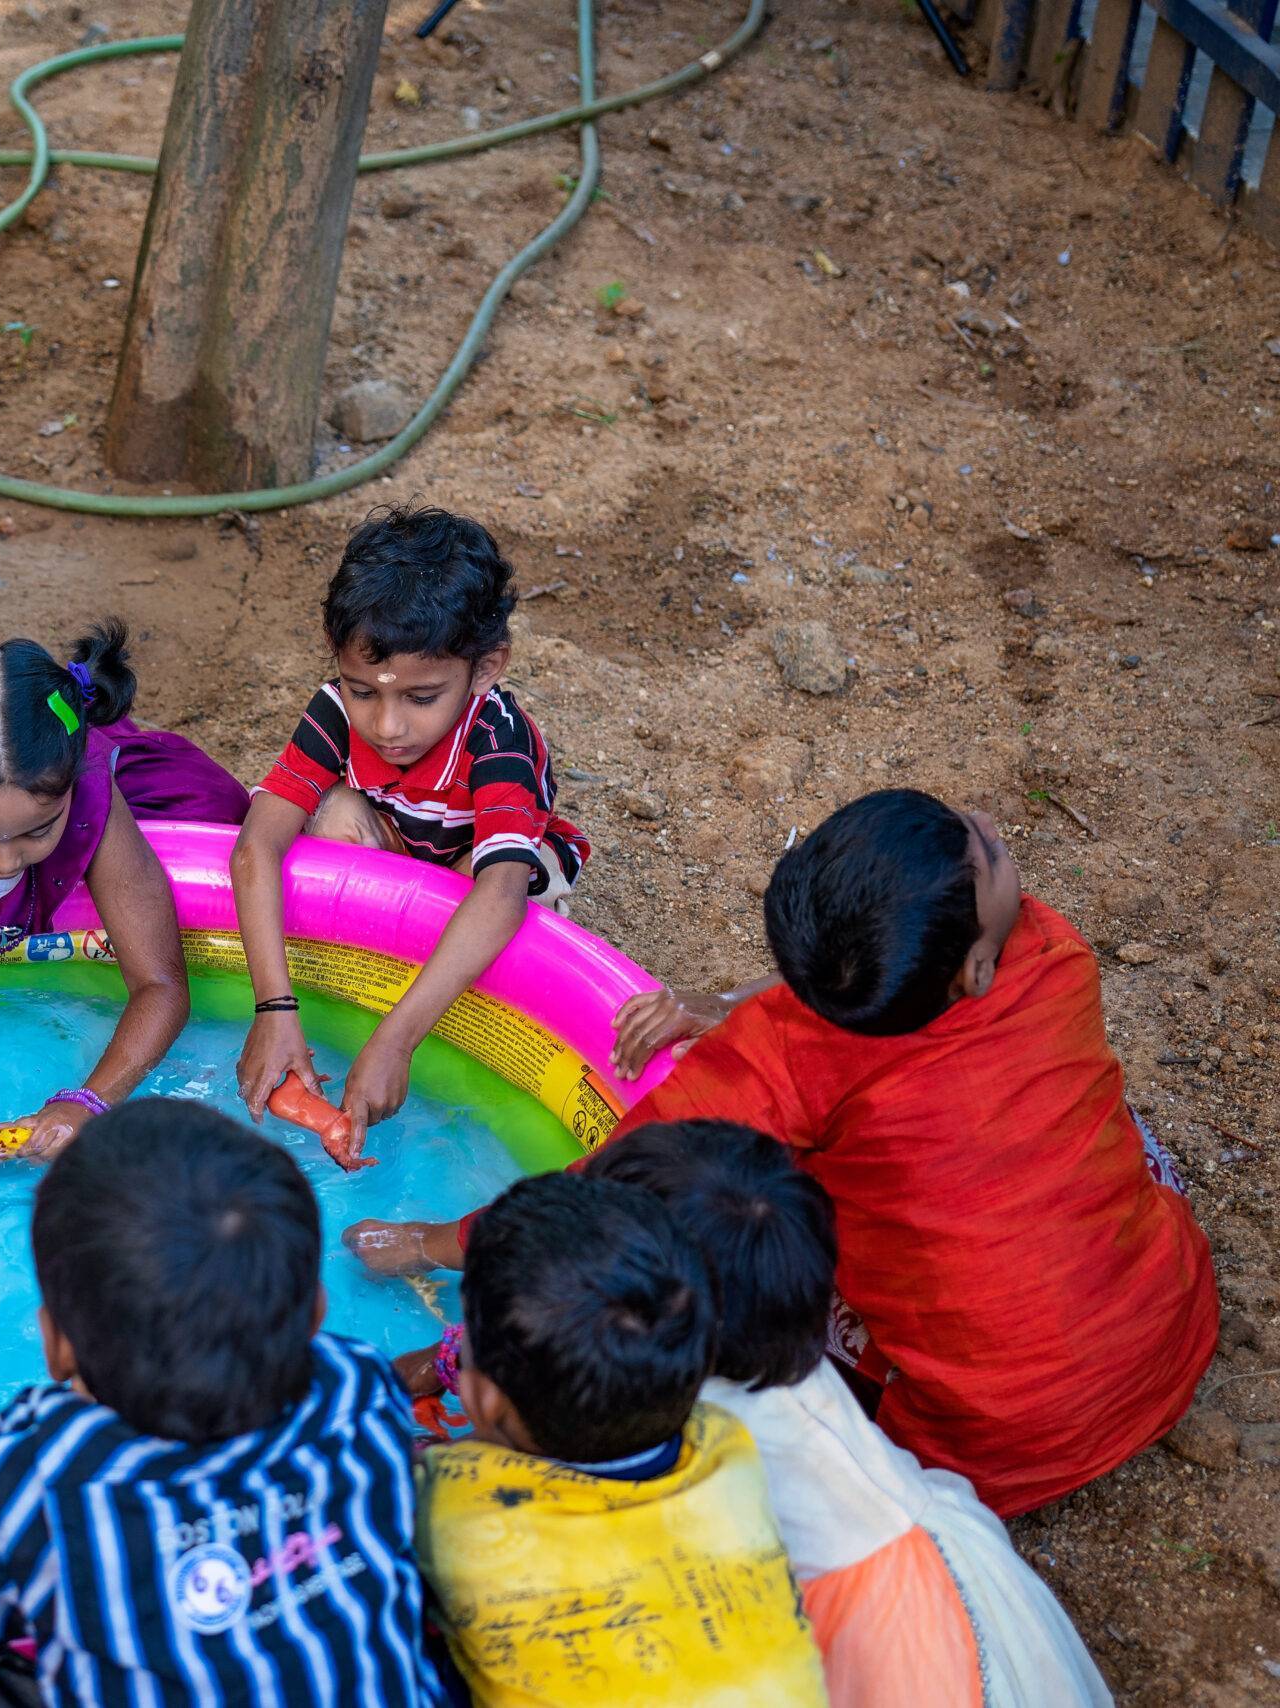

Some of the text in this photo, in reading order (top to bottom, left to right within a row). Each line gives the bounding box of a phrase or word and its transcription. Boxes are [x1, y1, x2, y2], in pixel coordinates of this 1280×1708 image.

[577, 1081, 587, 1092] NO
[584, 1088, 601, 1107] DIVING
[598, 1103, 606, 1114] OR
[577, 1094, 612, 1136] SHALLOW WATER
